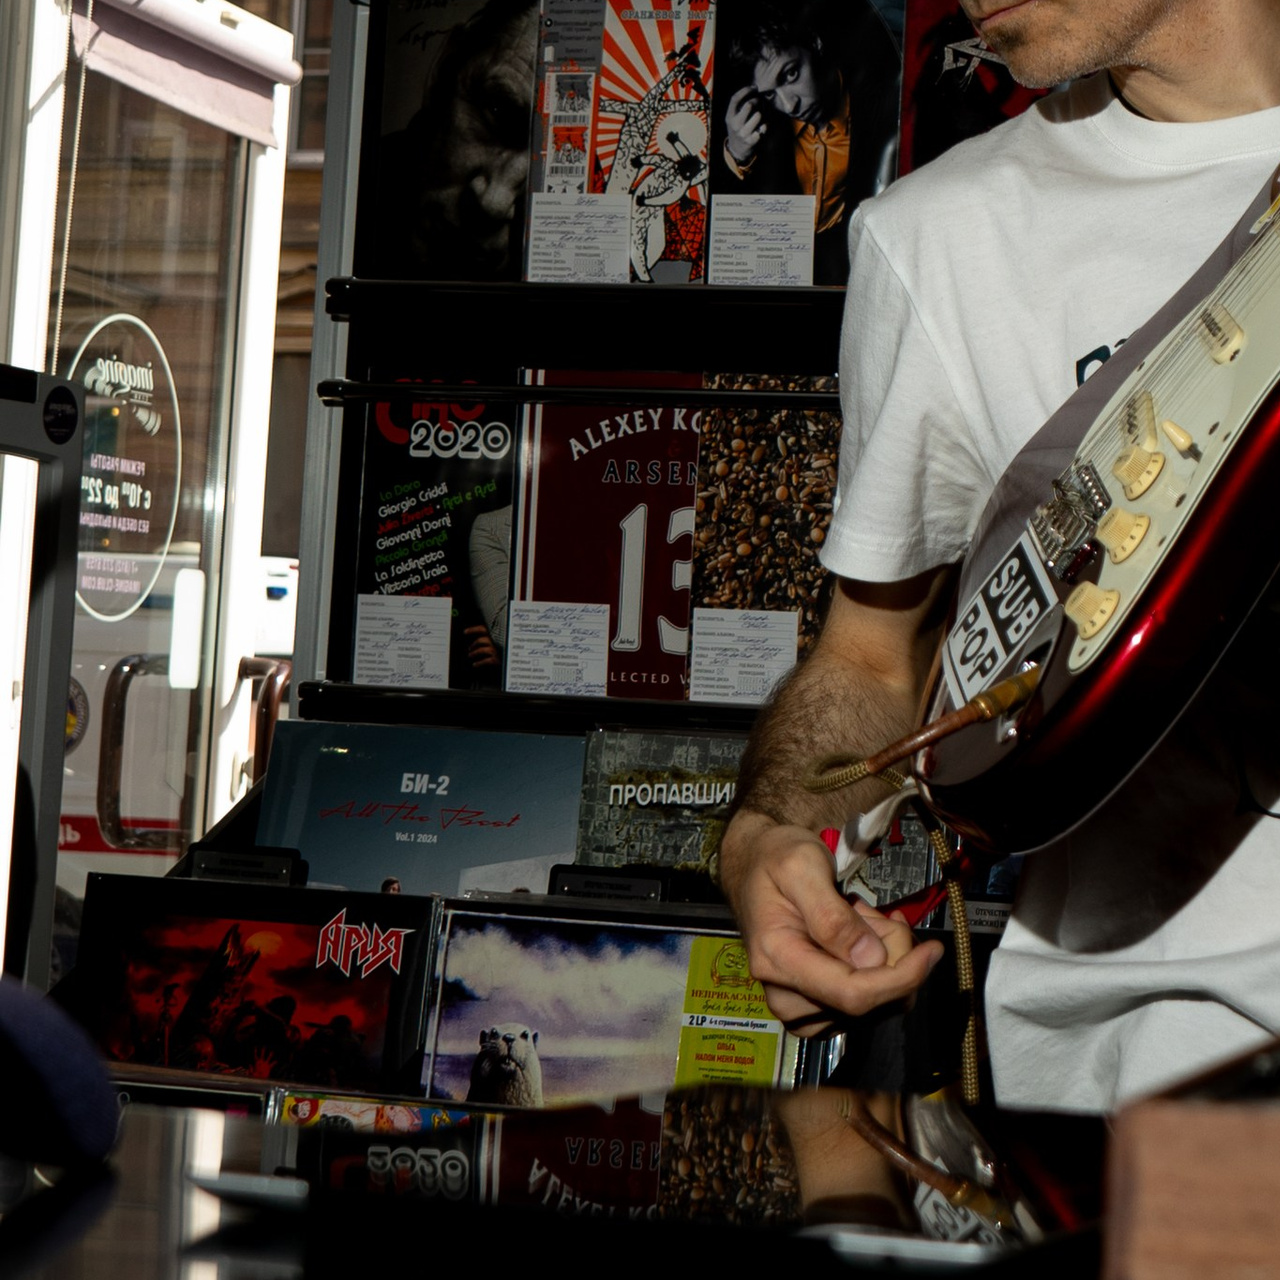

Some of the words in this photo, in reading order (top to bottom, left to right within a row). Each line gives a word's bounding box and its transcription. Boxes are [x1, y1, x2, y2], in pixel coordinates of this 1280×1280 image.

[409, 419, 512, 460] 2020
[568, 407, 664, 461] ALEXEY
[378, 496, 417, 518] Giorgio
[376, 524, 422, 550] Giovanni
[989, 557, 1041, 645] SUB
[953, 602, 999, 683] POP
[400, 772, 451, 796] БИ-2
[317, 801, 381, 820] All
[417, 834, 438, 844] 2024
[315, 906, 417, 980] АРИЯ
[696, 1016, 707, 1026] LP
